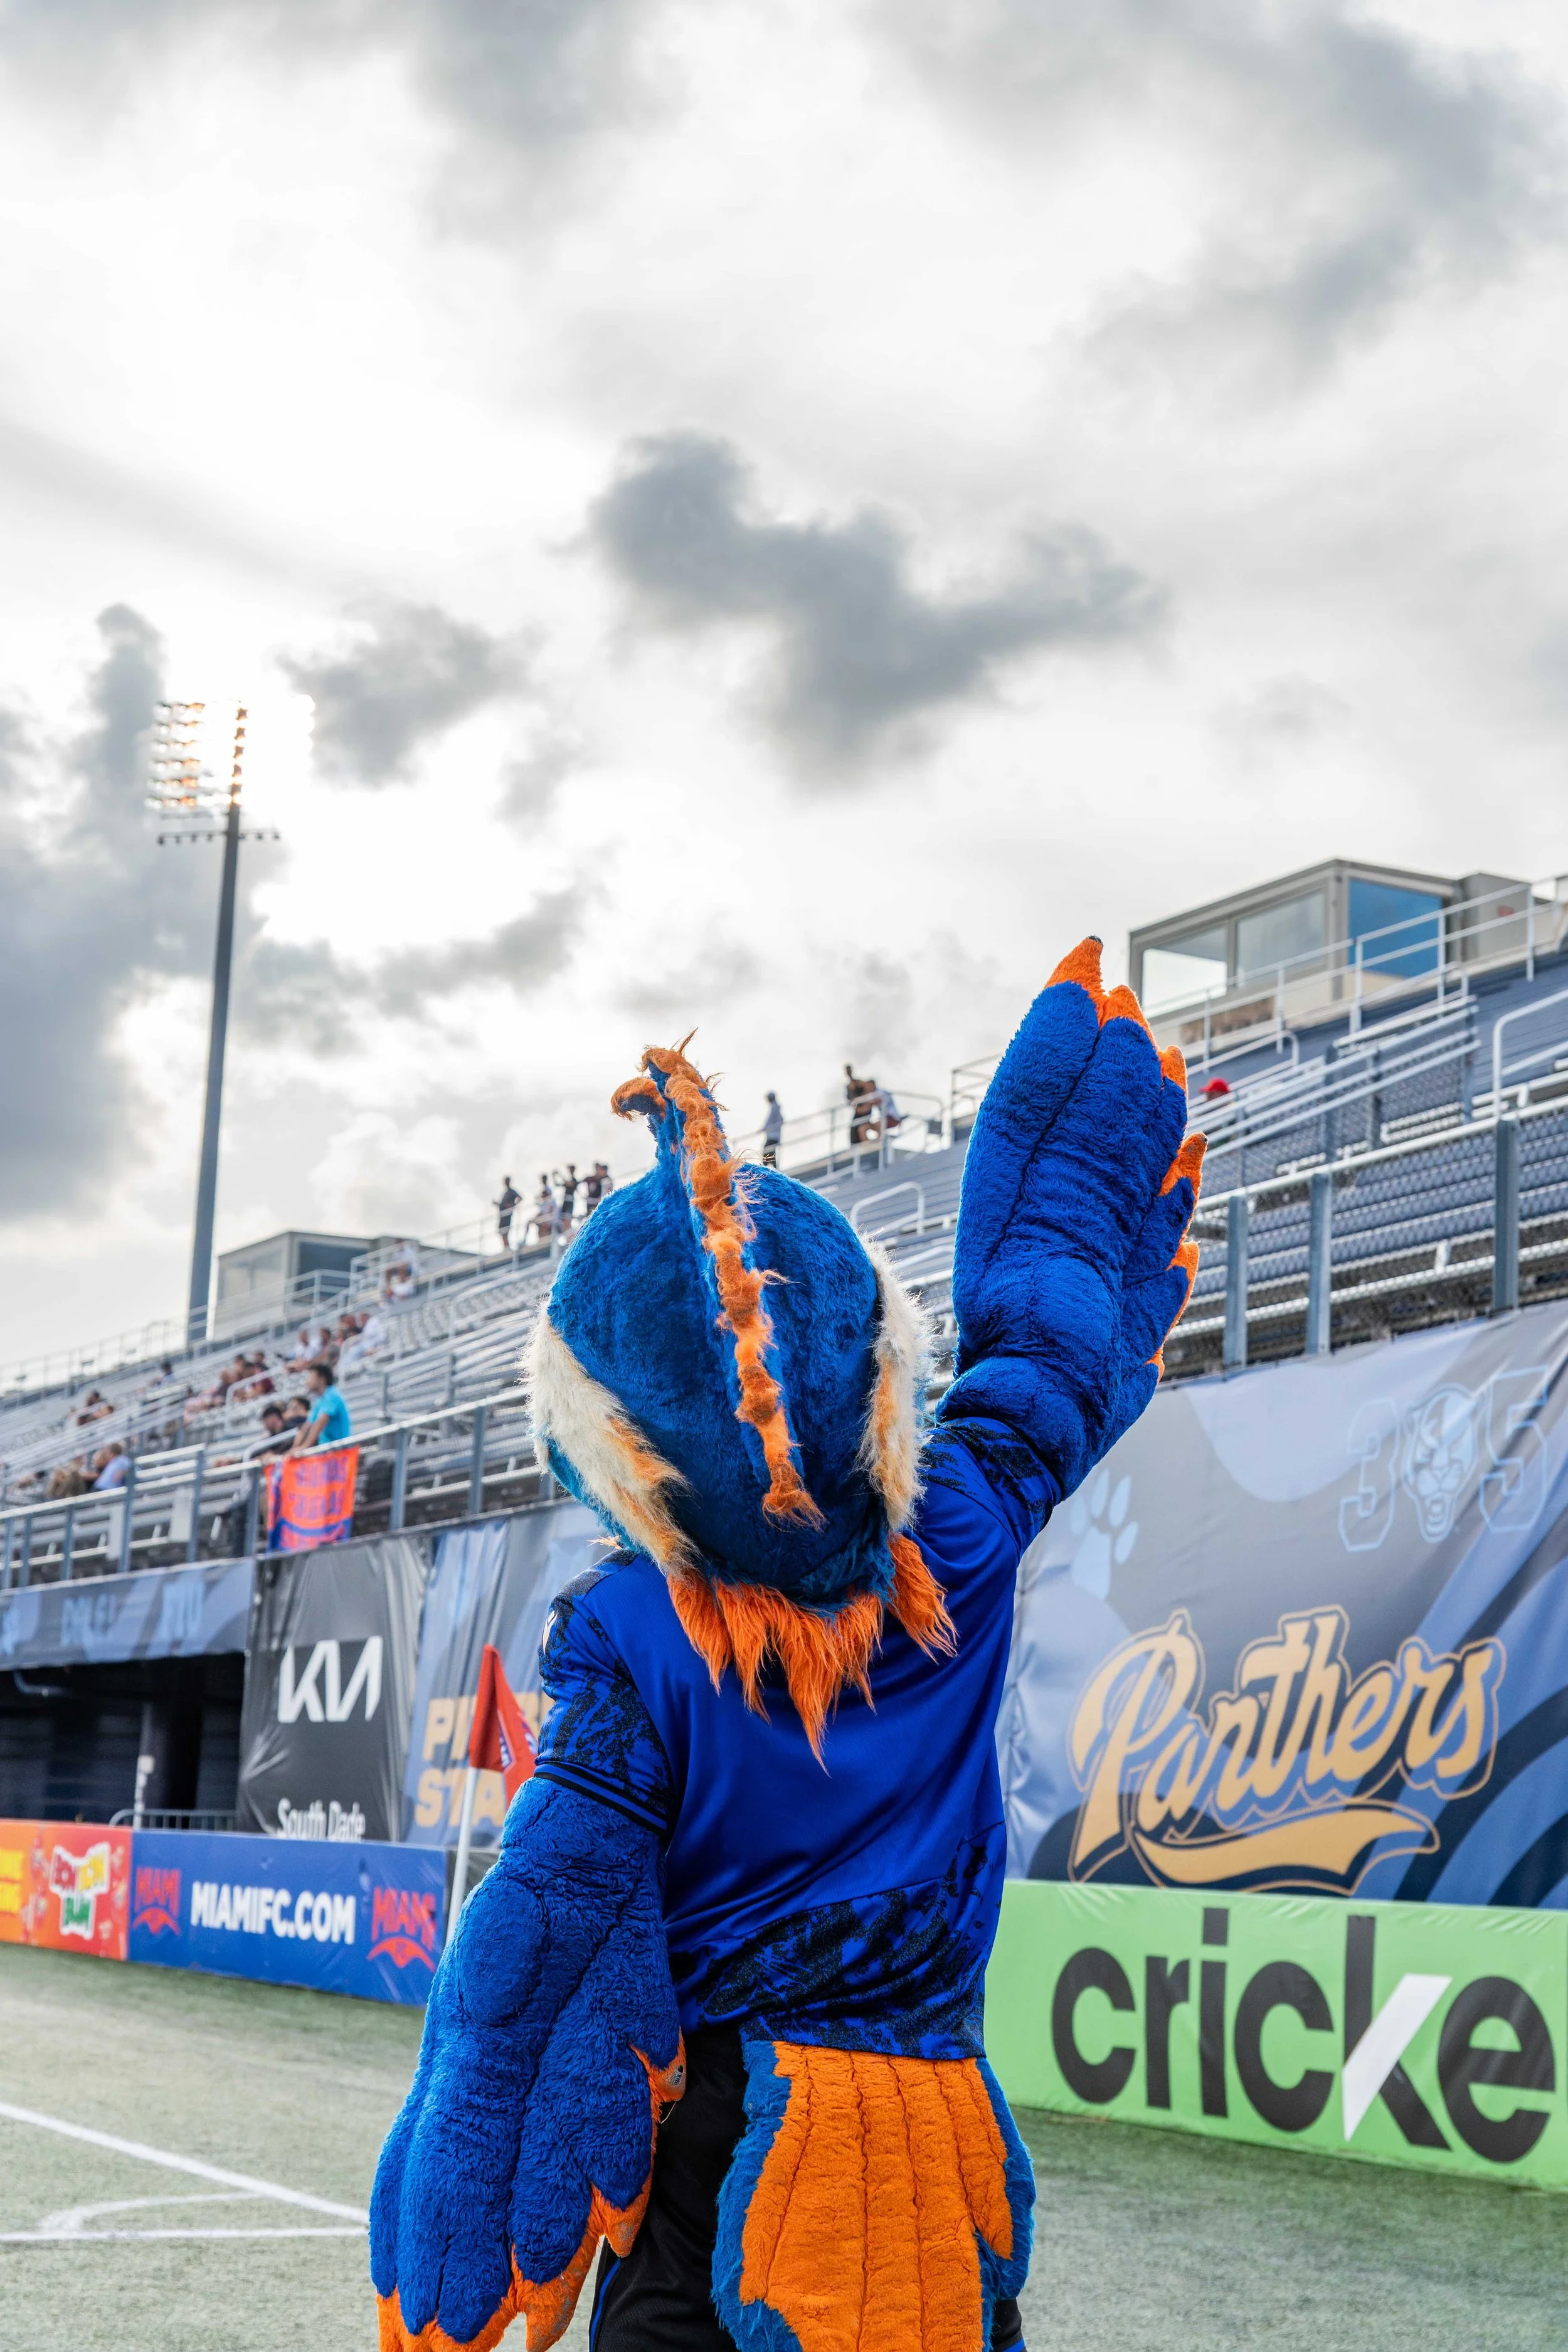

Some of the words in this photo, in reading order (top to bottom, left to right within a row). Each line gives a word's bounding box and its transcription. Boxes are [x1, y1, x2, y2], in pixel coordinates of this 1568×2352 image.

[277, 1797, 327, 1840] South
[327, 1799, 366, 1842] Dade
[1069, 1607, 1503, 1875] Panthers
[189, 1880, 357, 1946] MIAMIFC.COM
[1050, 1906, 1568, 2166] cricke
